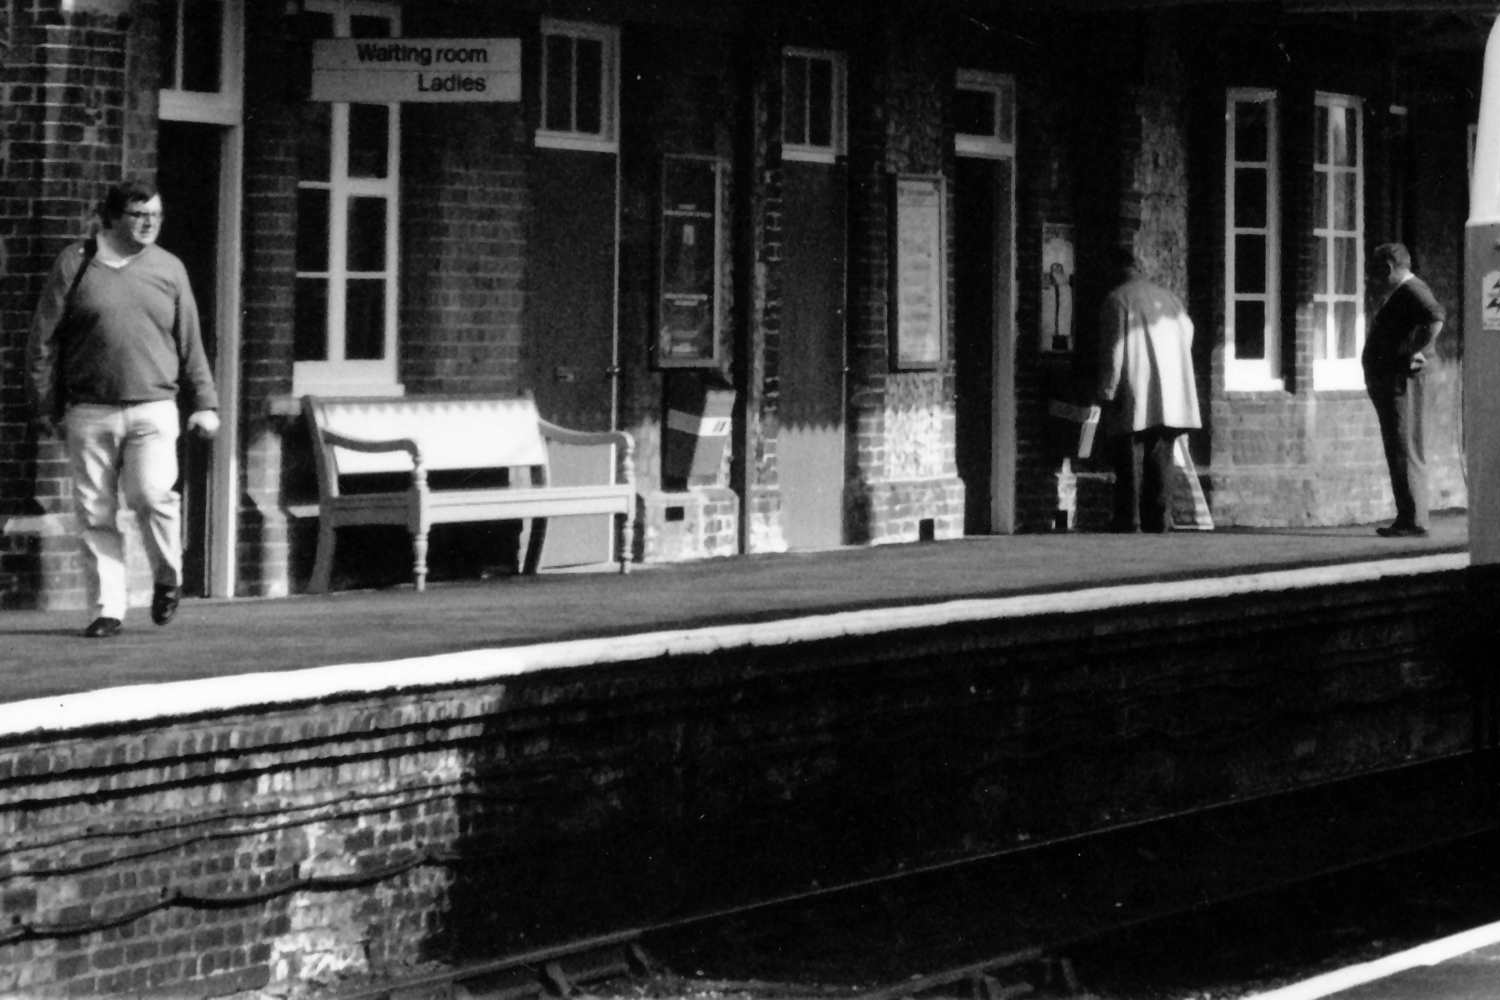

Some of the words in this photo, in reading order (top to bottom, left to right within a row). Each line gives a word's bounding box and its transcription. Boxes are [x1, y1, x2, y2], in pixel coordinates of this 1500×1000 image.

[356, 44, 431, 66] Waiting
[436, 47, 488, 63] room
[417, 74, 487, 92] Ladies
